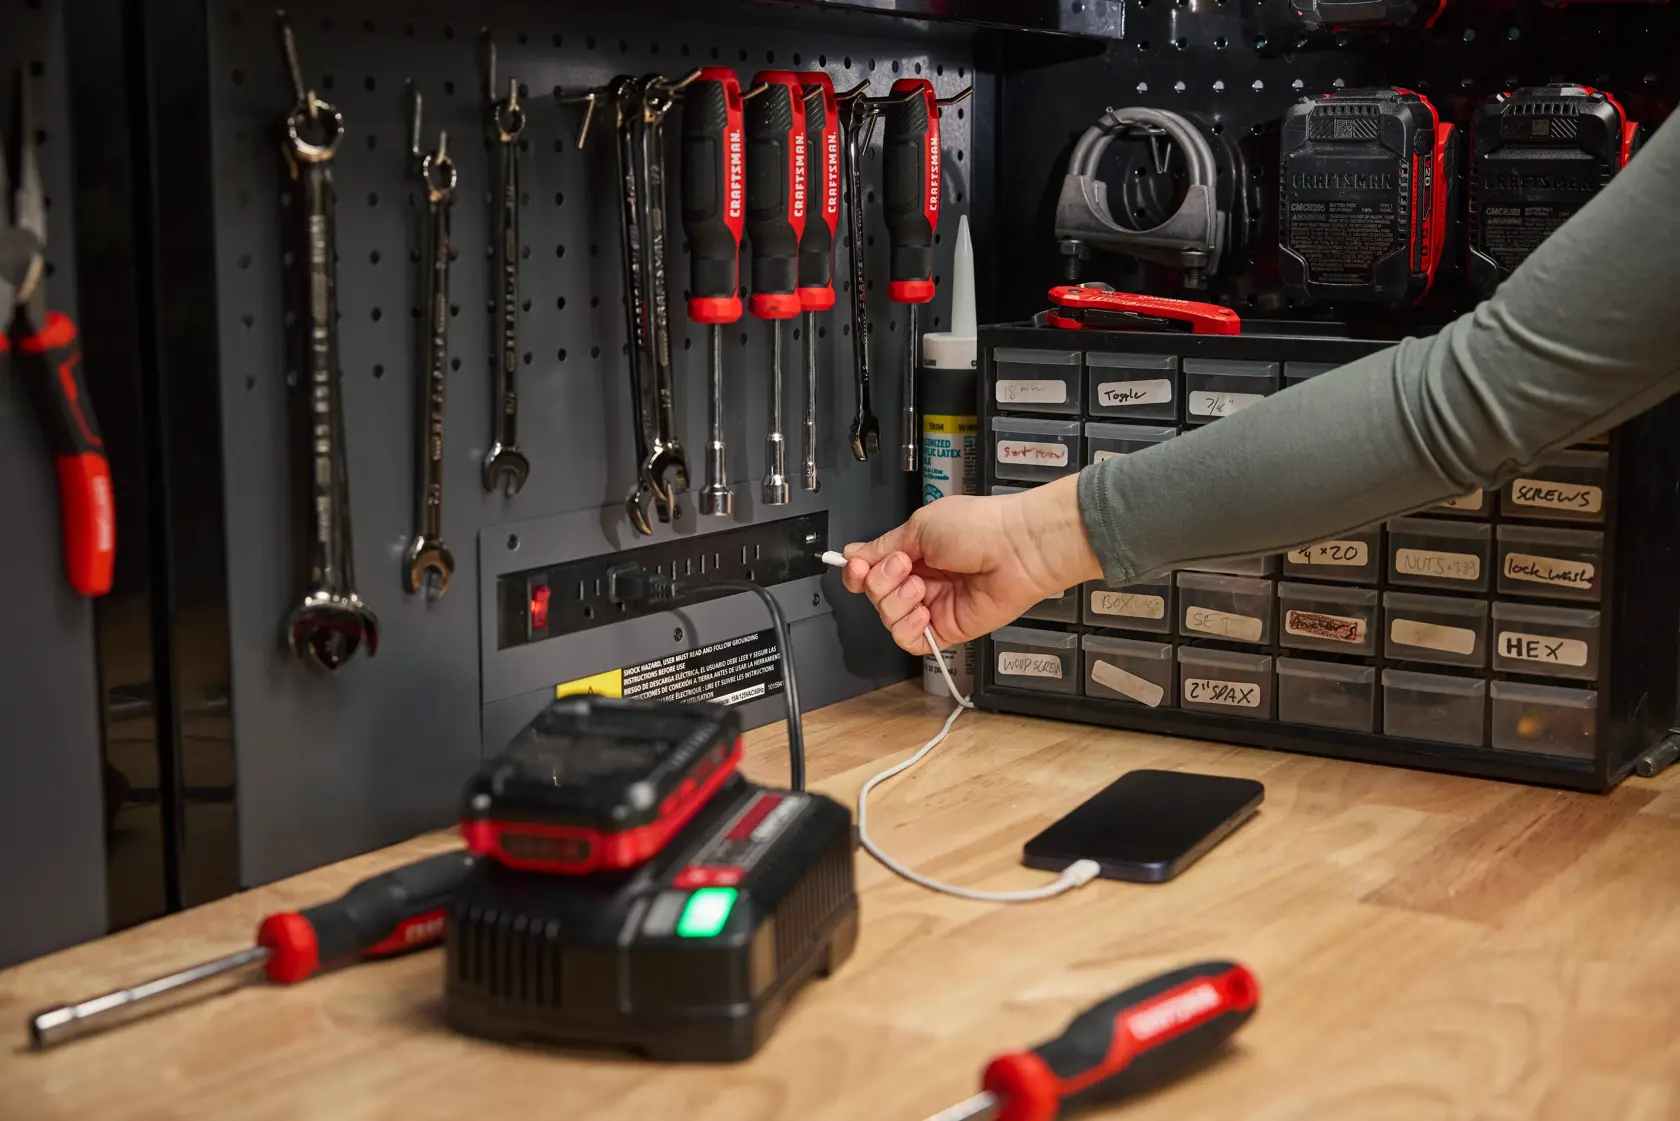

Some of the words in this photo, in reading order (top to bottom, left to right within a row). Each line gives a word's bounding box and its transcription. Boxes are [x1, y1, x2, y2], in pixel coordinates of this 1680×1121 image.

[1292, 173, 1393, 189] CRAFTSMAN
[1104, 388, 1147, 403] Toggle
[937, 449, 961, 458] LATEX
[1516, 485, 1592, 507] SCREWS
[623, 666, 641, 677] SHOCK
[640, 660, 662, 672] HAZARD,
[662, 656, 675, 666] USER
[675, 653, 689, 662] MUST
[689, 650, 702, 658] READ
[702, 646, 713, 655] AND
[713, 641, 732, 652] FOLLOW
[732, 634, 759, 646] GROUNDING
[1506, 637, 1564, 661] HEX
[623, 685, 641, 696] RIESGO
[642, 682, 649, 690] DE
[650, 675, 675, 688] DESCARGA
[706, 660, 726, 671] USUARIO
[726, 656, 738, 665] DEBE
[738, 653, 749, 663] LEER
[752, 648, 768, 658] SEGUIR
[768, 645, 777, 654] LAS
[623, 670, 658, 686] INSTRUCTIONS
[658, 665, 676, 676] BEFORE
[676, 662, 686, 671] USE
[697, 672, 714, 683] TIERRA
[713, 668, 728, 678] ANTES
[728, 666, 735, 674] DE
[735, 662, 747, 672] USAR
[747, 660, 754, 668] LA
[704, 682, 714, 691] LIRE
[714, 680, 720, 688] ET
[720, 675, 736, 686] SUIVRE
[736, 672, 744, 681] LES
[744, 664, 775, 678] INSTRUCTIONS
[1209, 684, 1254, 705] SPAX
